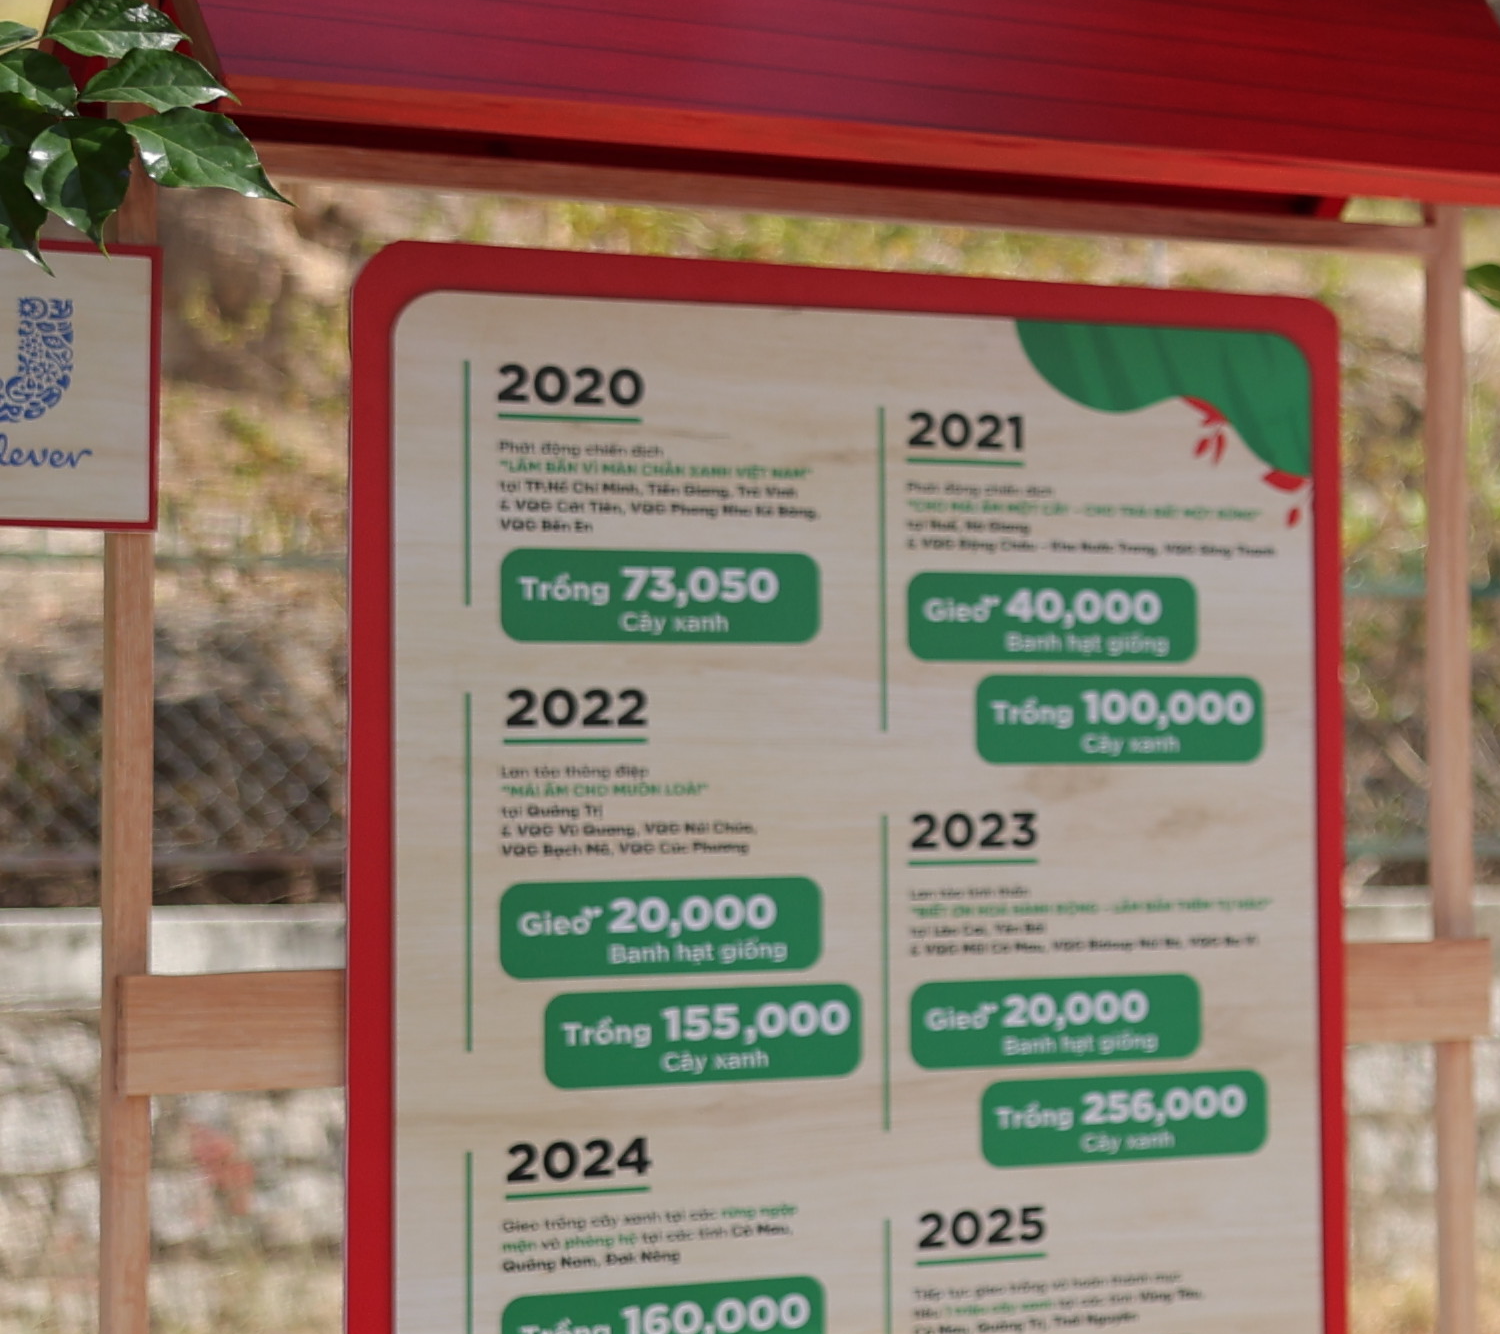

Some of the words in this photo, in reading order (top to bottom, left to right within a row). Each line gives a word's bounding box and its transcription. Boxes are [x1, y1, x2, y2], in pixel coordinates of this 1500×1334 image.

[497, 364, 645, 407] 2020
[908, 412, 1024, 450] 2021
[619, 568, 779, 608] 73,050
[618, 611, 666, 635] Cây
[674, 613, 729, 633] xanh
[1006, 588, 1162, 629] 40,000
[1006, 632, 1062, 652] Banh
[1067, 632, 1102, 657] hạt
[1108, 630, 1170, 656] giống
[506, 688, 647, 728] 2022
[1081, 689, 1255, 729] 100,000
[1081, 733, 1124, 756] Cây
[1129, 735, 1180, 753] xanh
[910, 812, 1037, 849] 2023
[608, 895, 777, 938] 20,000
[608, 944, 669, 965] Banh
[678, 943, 714, 965] hạt
[720, 937, 789, 964] giống
[660, 1000, 851, 1044] 155,000
[1003, 990, 1149, 1030] 20,000
[660, 1051, 707, 1075] Cây
[713, 1049, 769, 1069] xanh
[1003, 1036, 1057, 1056] Banh
[1060, 1034, 1095, 1058] hạt
[1080, 1085, 1247, 1126] 256,000
[507, 1137, 651, 1183] 2024
[1080, 1131, 1122, 1154] Cây
[1126, 1130, 1175, 1150] xanh
[918, 1206, 1047, 1249] 2025
